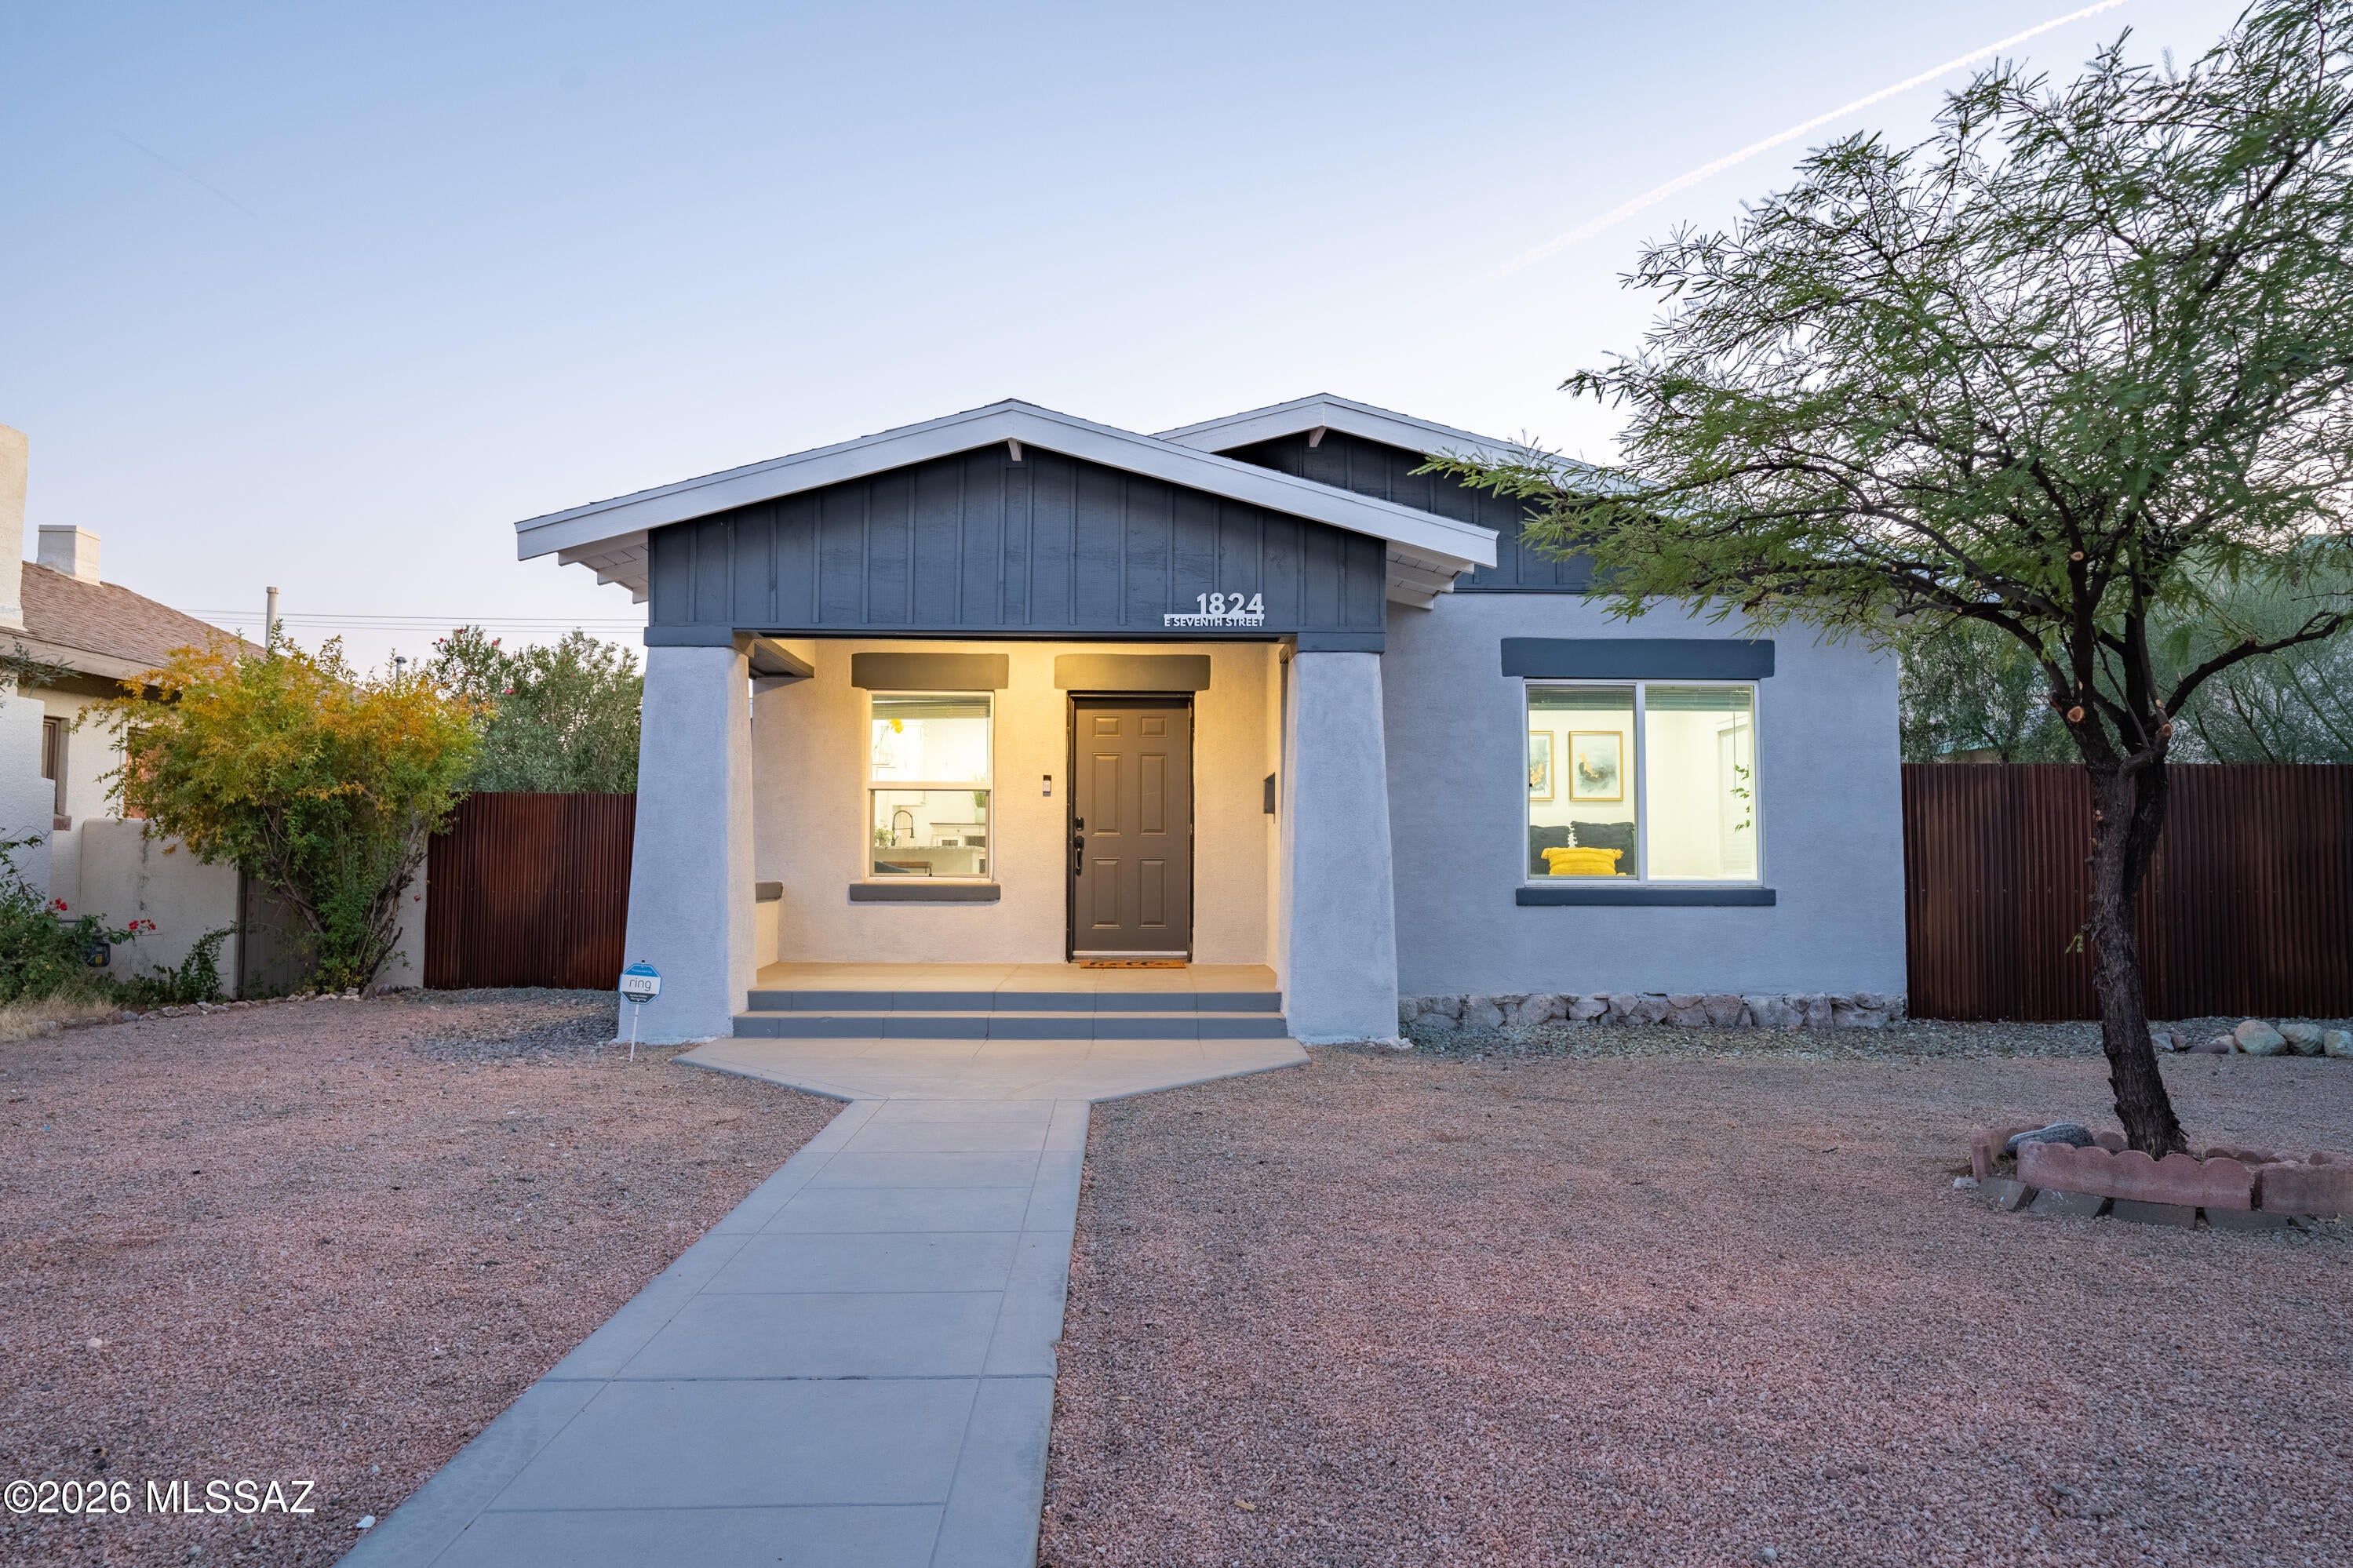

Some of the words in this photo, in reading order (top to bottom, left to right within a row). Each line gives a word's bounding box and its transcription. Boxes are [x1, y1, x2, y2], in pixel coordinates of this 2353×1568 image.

[1197, 592, 1265, 615] 1824
[1164, 617, 1171, 627] E
[1173, 617, 1223, 627] SEVENTH
[1226, 617, 1263, 627] STREET
[629, 977, 652, 991] ring
